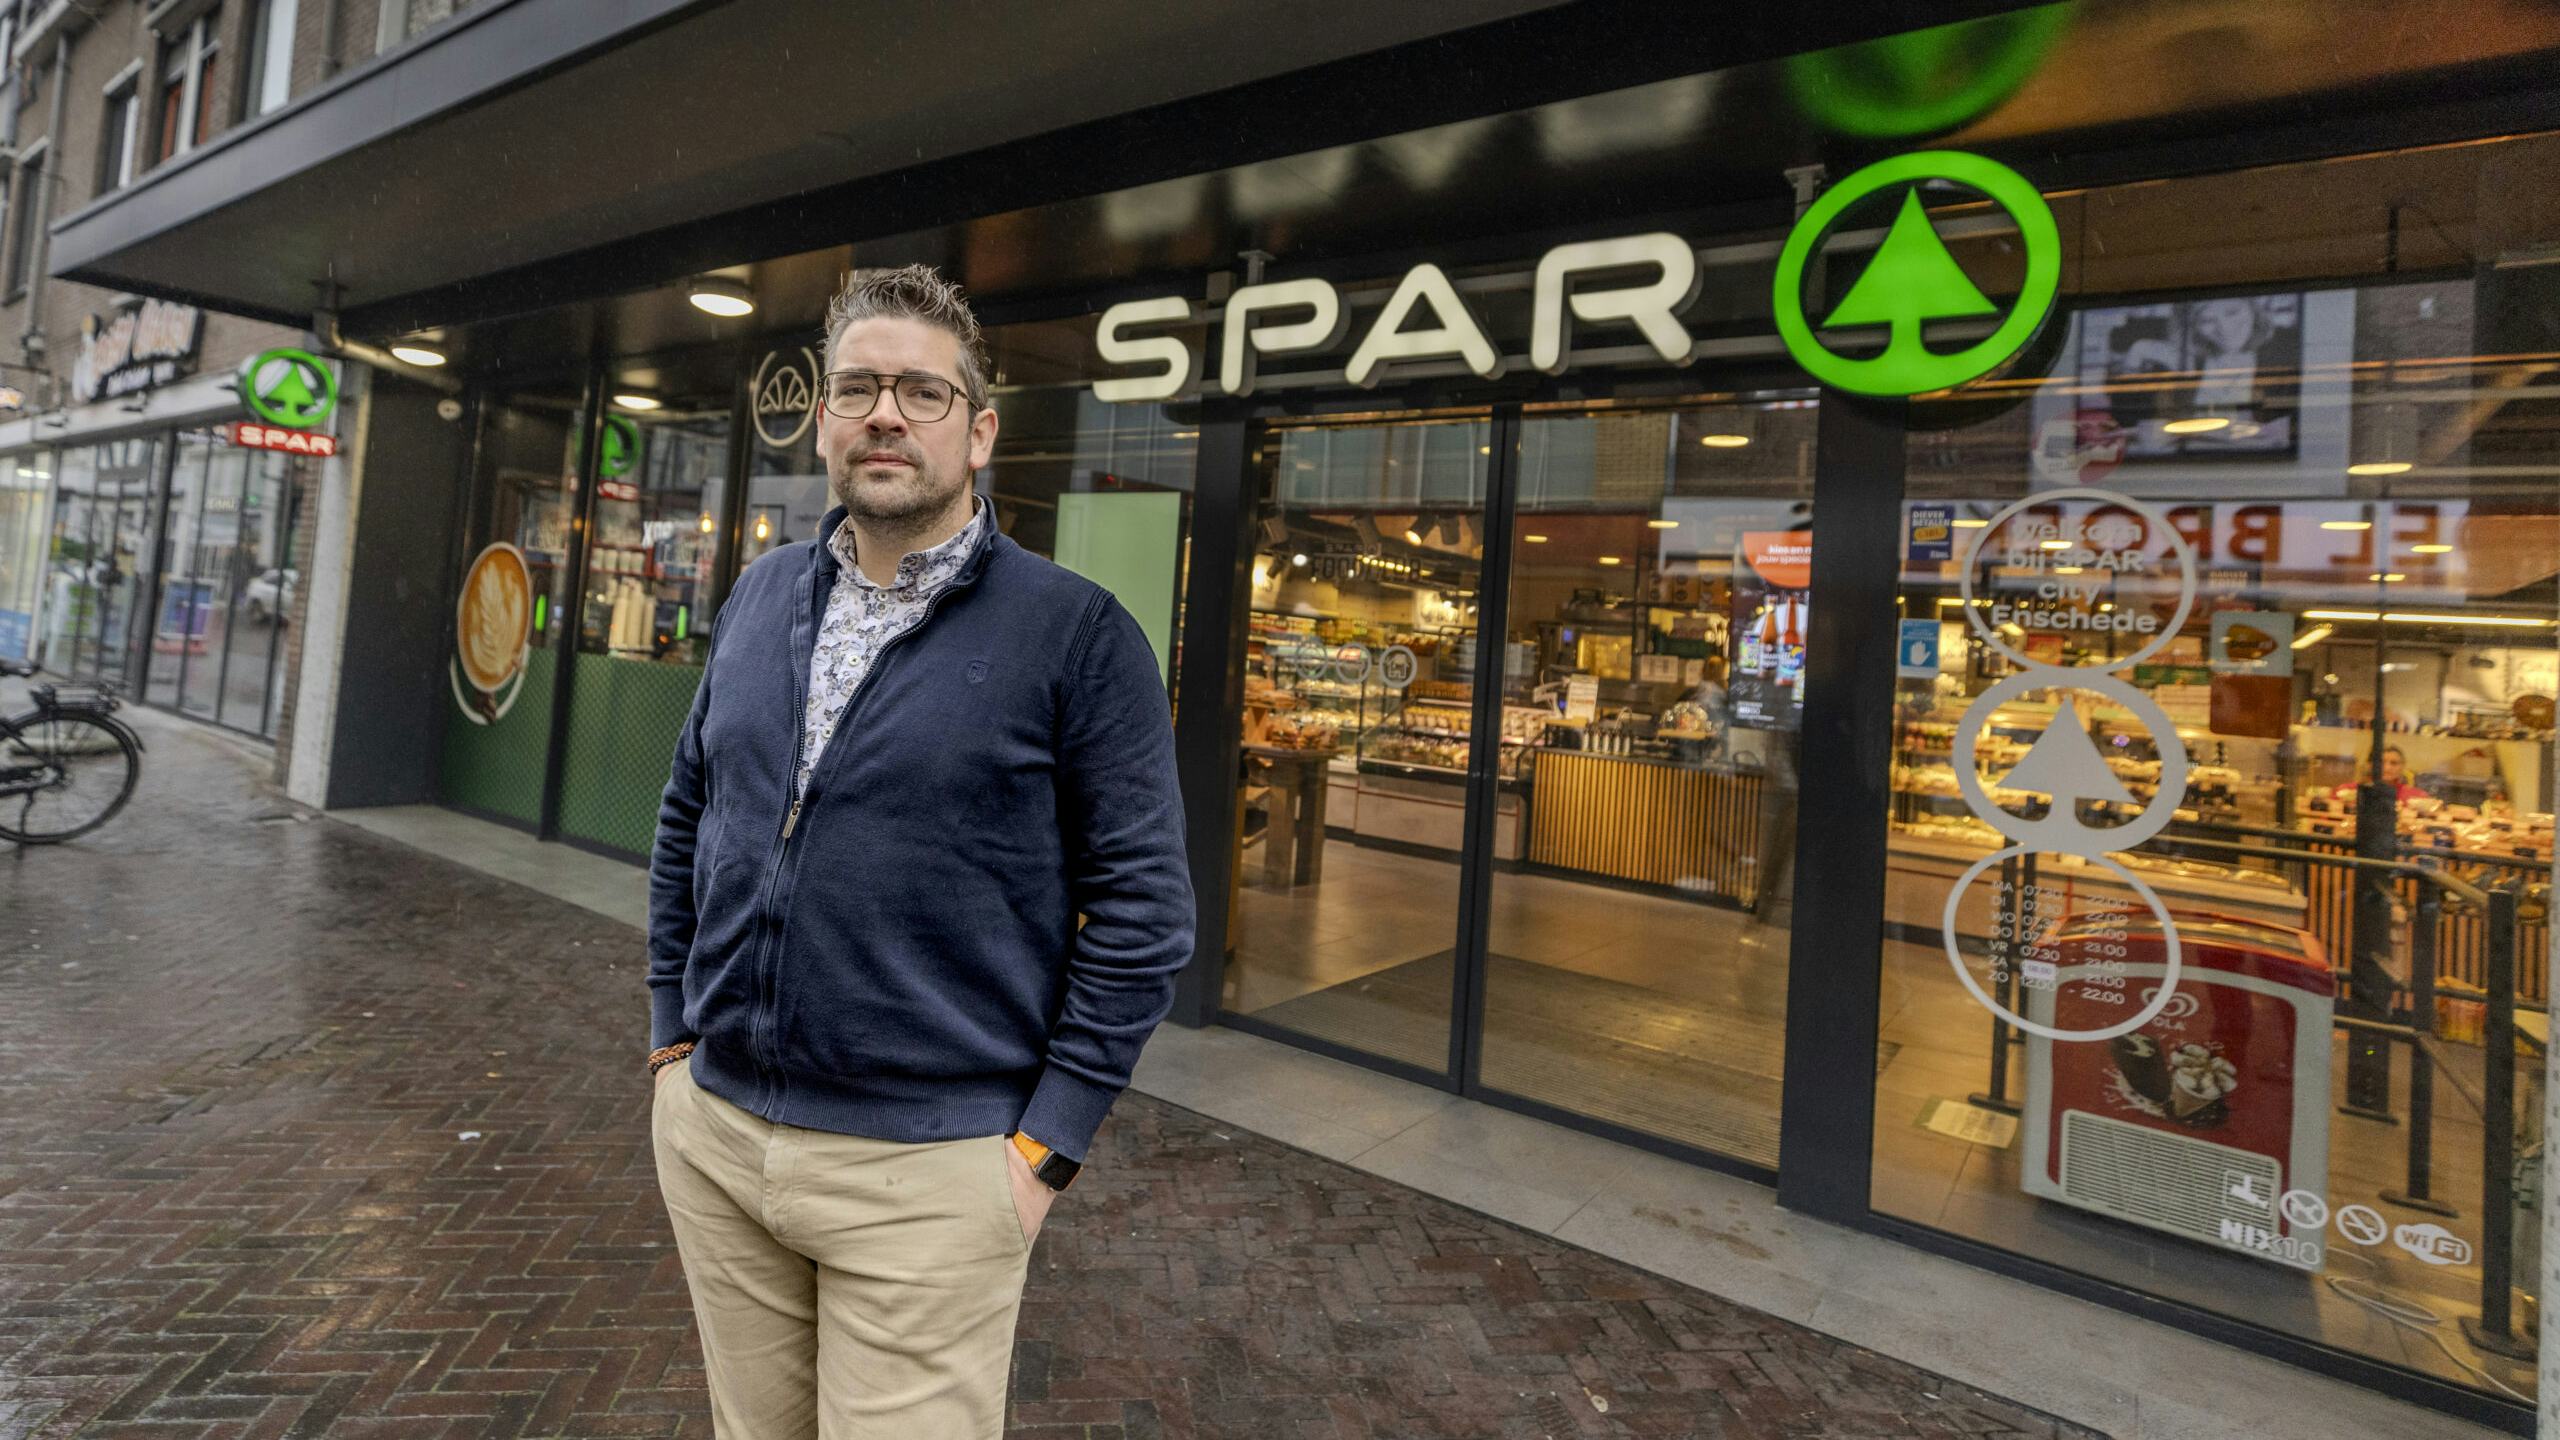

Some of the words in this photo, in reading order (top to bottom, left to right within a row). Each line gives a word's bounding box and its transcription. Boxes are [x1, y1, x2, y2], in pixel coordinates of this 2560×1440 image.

[1092, 231, 1702, 403] SPAR
[239, 425, 334, 456] SPAR
[2010, 518, 2143, 544] welkom
[2008, 549, 2045, 575] bij
[2053, 549, 2145, 572] SPAR
[2038, 580, 2101, 606] city
[1990, 604, 2157, 633] Enschede
[1990, 911, 2017, 924] WO
[1990, 925, 2013, 938] DO
[1987, 940, 2009, 952] VR
[1988, 955, 2009, 968] ZA
[1987, 969, 2009, 983] ZO
[2153, 1015, 2186, 1031] OLA
[2219, 1217, 2322, 1266] NIX18
